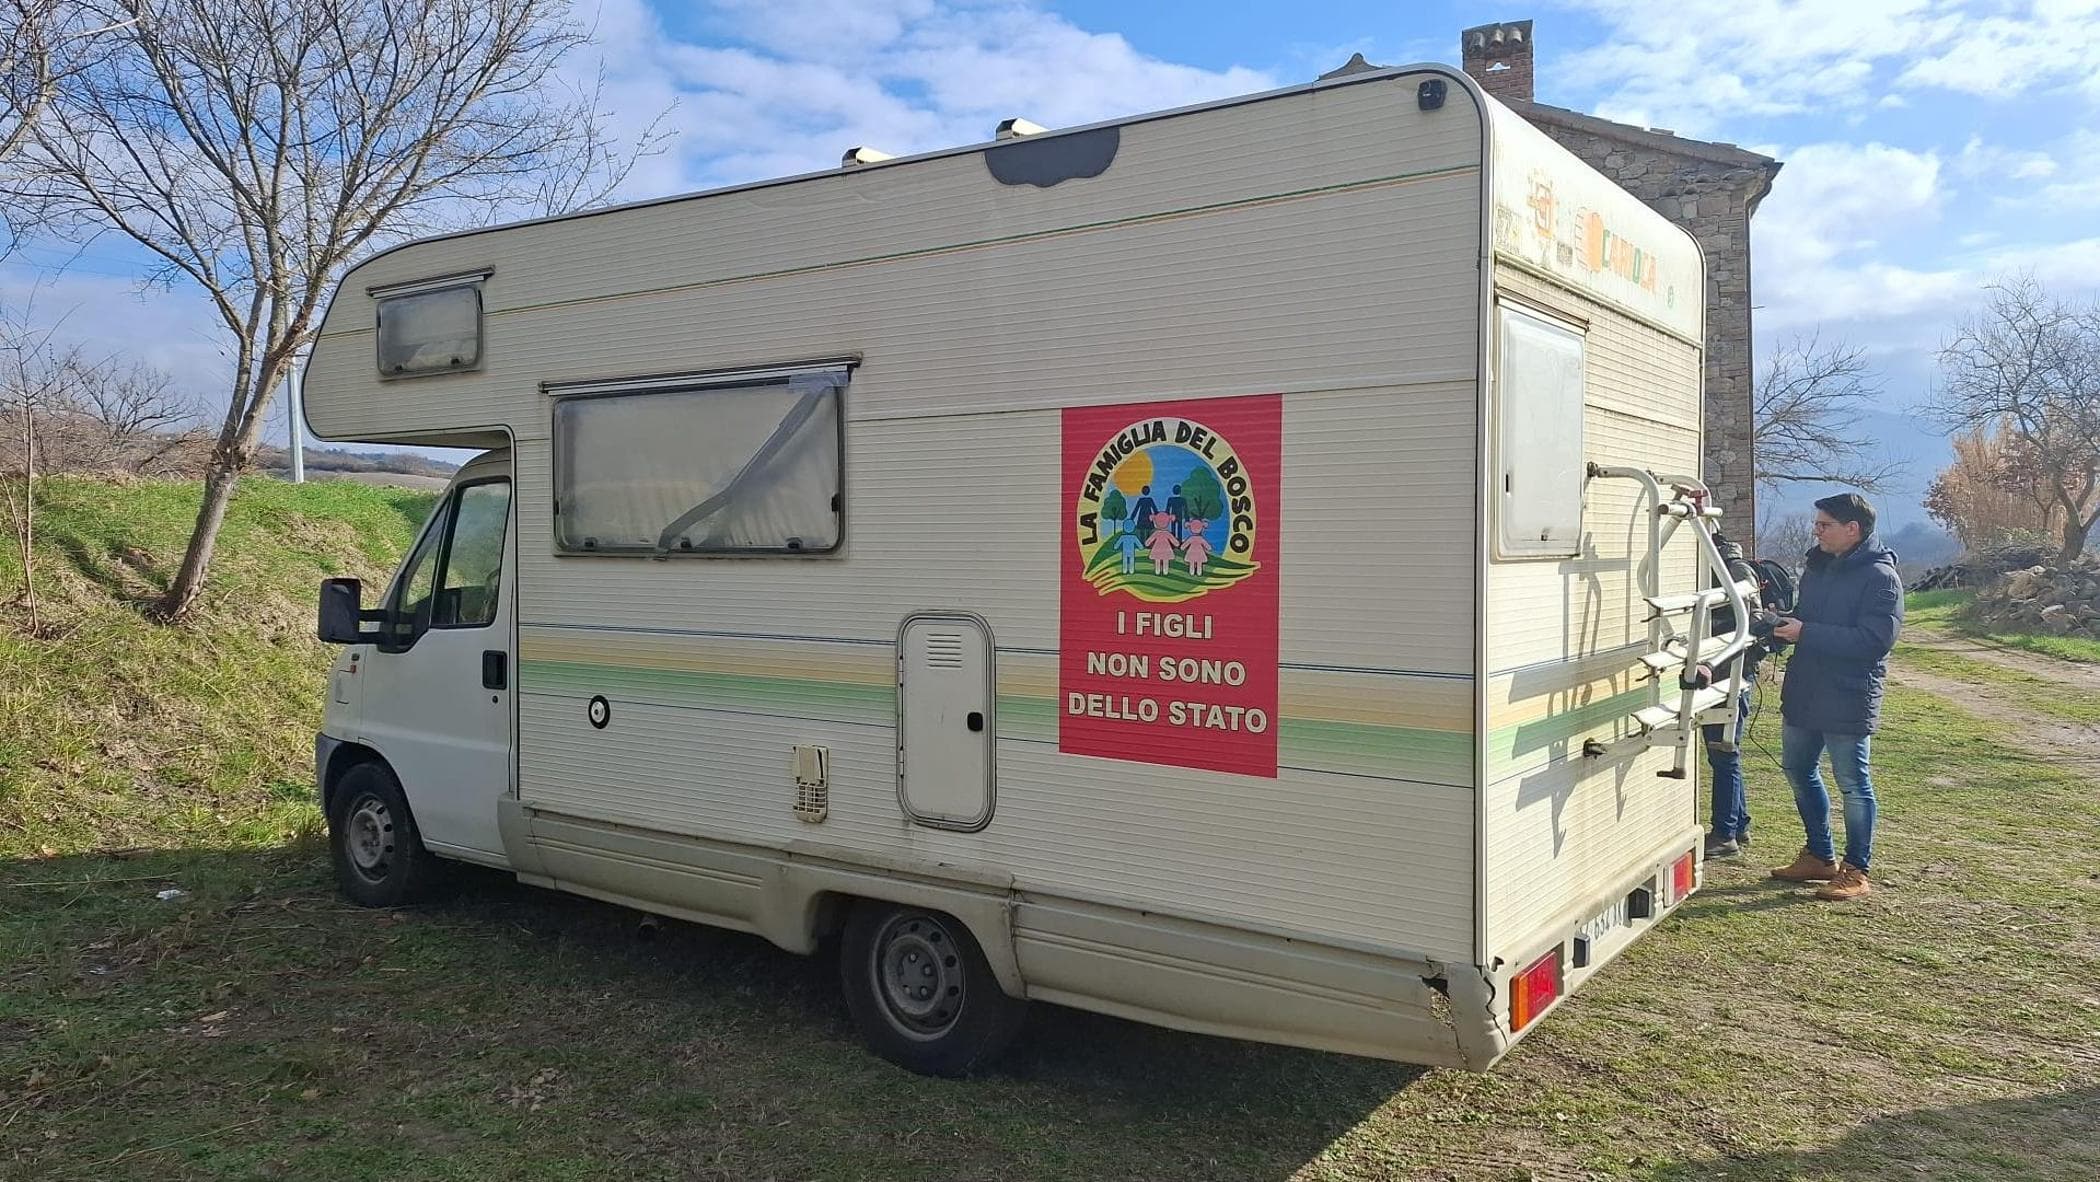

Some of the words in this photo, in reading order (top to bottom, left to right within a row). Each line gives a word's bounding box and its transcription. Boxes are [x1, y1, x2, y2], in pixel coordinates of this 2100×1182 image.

[1174, 420, 1218, 460] DEL
[1084, 420, 1167, 503] FAMIGLIA
[1216, 455, 1254, 554] BOSCO
[1080, 512, 1098, 546] LA
[1117, 611, 1126, 635] I
[1135, 612, 1213, 640] FIGLI
[1087, 651, 1150, 679] NON
[1158, 656, 1247, 687] SONO
[1067, 692, 1160, 723] DELLO
[1168, 700, 1268, 734] STATO
